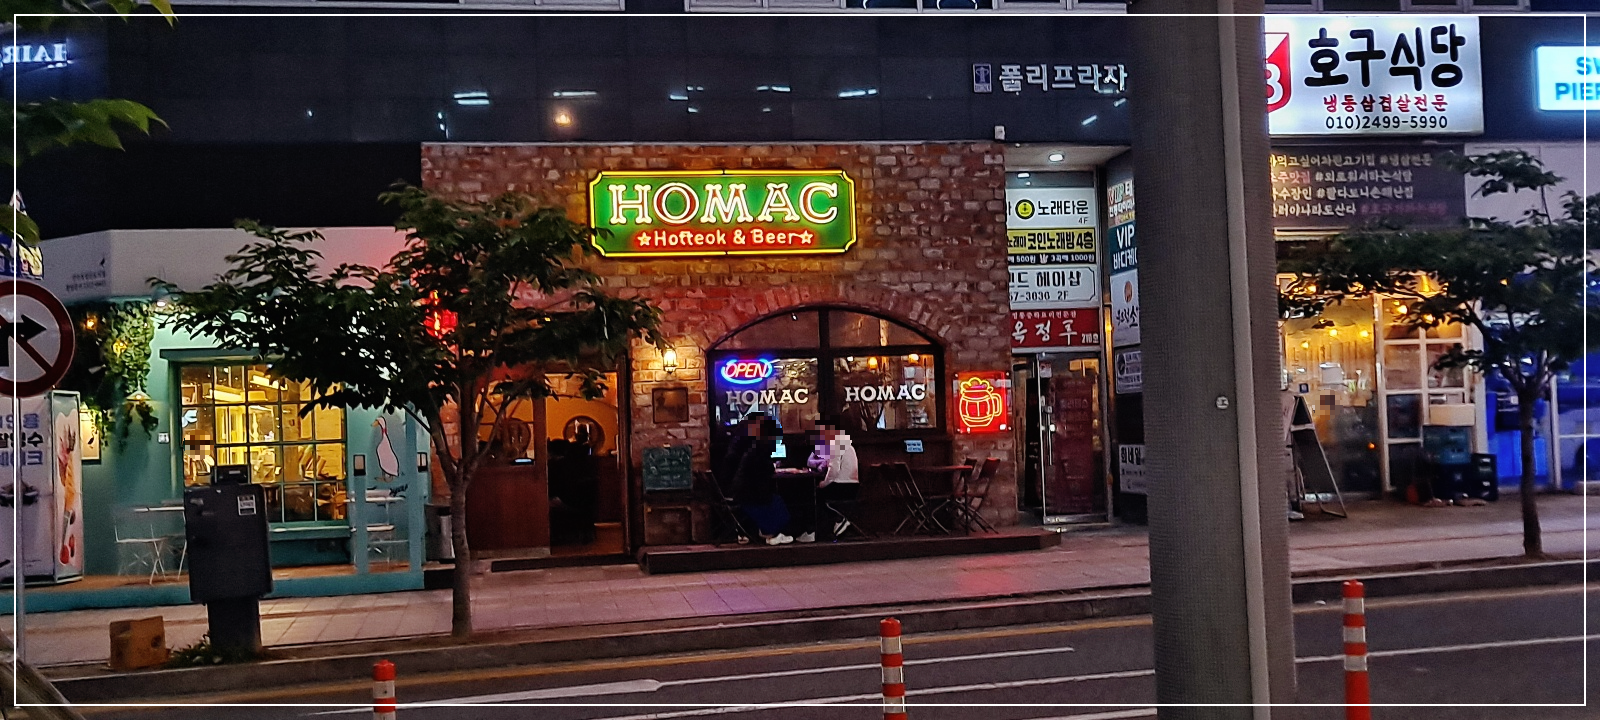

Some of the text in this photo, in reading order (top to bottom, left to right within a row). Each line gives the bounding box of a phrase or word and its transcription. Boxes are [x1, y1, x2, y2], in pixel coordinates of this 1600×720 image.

[1304, 24, 1466, 91] 호구식당
[1323, 93, 1449, 113] 냉동삼겹살전문
[1325, 114, 1449, 131] 010)2499-5990
[607, 181, 839, 225] HOMAC
[1037, 200, 1089, 216] 노래타운
[1078, 216, 1089, 225] 4F
[733, 228, 746, 245] &
[750, 228, 797, 245] Beer
[1116, 224, 1136, 249] VIP
[1057, 290, 1069, 300] 2F
[725, 362, 768, 378] OPEN
[725, 388, 809, 406] HOMAC
[844, 383, 926, 402] HOMAC
